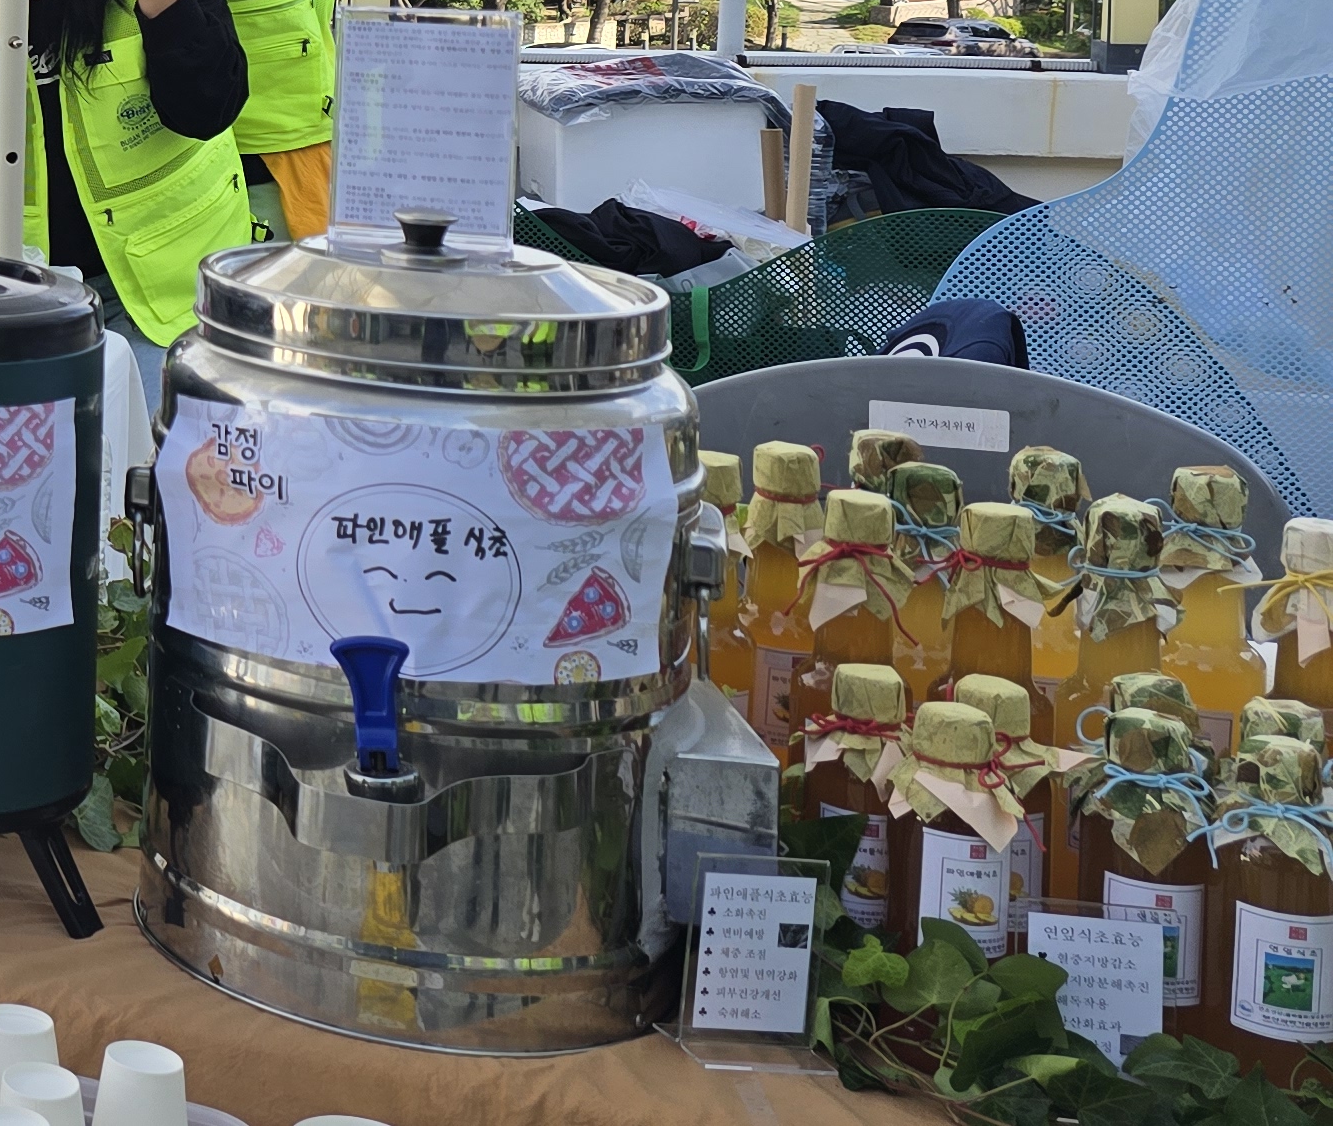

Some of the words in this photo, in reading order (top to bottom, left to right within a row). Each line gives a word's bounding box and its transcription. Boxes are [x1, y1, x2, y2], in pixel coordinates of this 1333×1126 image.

[903, 416, 977, 433] 주민자치위원
[211, 423, 259, 462] 감정
[230, 467, 284, 501] 파이
[331, 513, 453, 556] 파인애플
[463, 526, 510, 561] 식초
[709, 885, 814, 905] 파인애플식초효능
[722, 907, 767, 921] 소화촉진
[721, 926, 765, 941] 변비예방
[1043, 925, 1144, 948] 연잎식초효능
[714, 986, 782, 1002] 피부건강개선
[717, 1005, 763, 1021] 숙취해소
